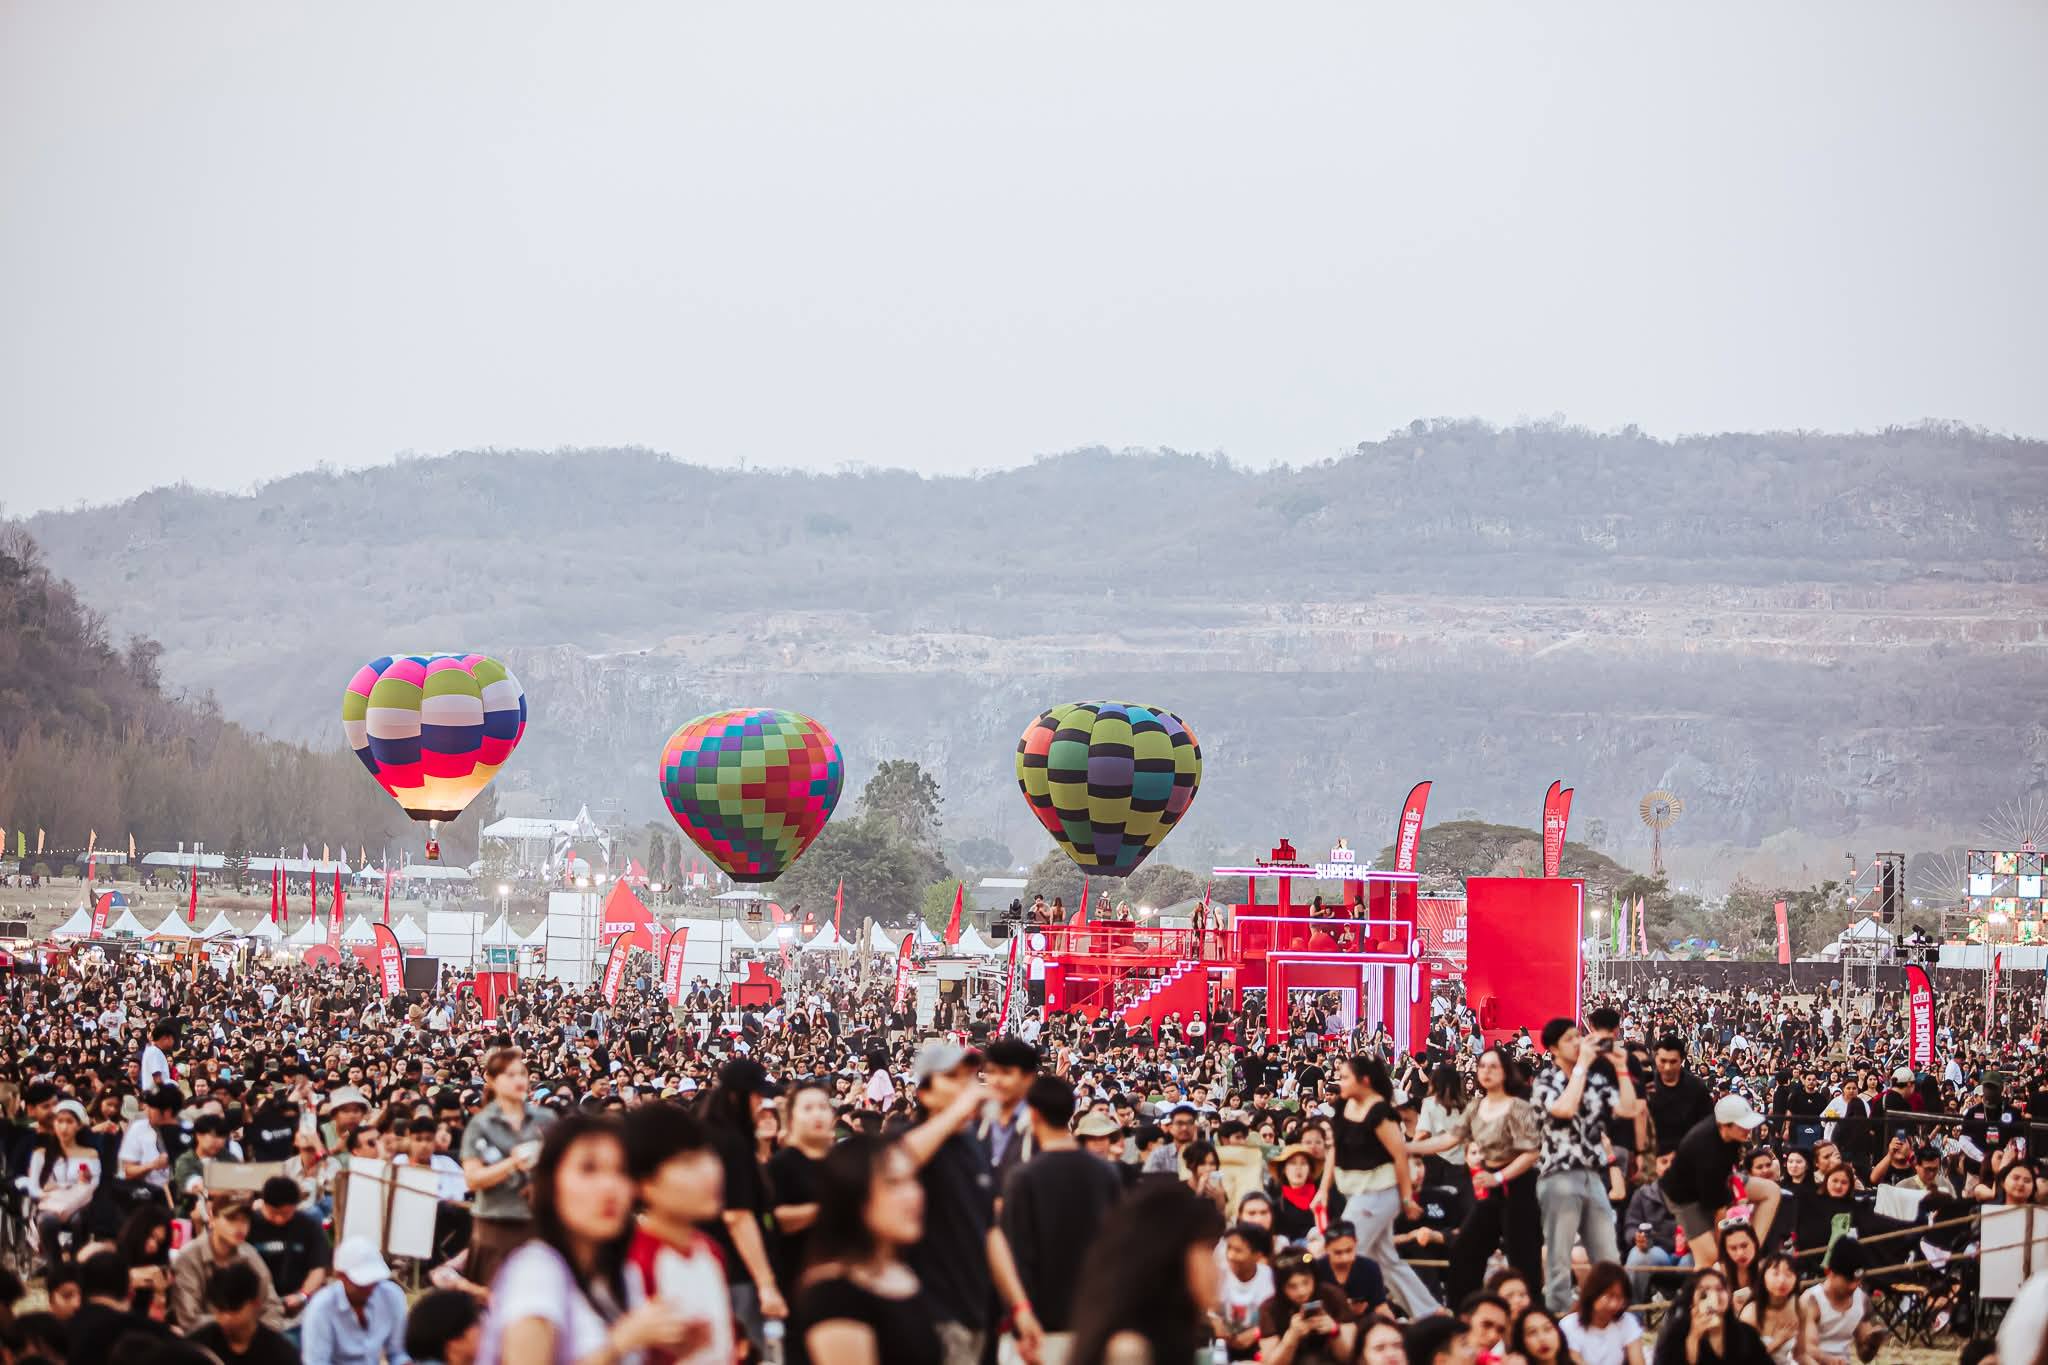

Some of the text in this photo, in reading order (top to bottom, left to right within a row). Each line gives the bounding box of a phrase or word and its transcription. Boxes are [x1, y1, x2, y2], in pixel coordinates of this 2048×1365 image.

[1398, 821, 1419, 870] SUPREME
[1332, 851, 1354, 861] LEO
[1315, 864, 1369, 880] SUPREME
[607, 923, 635, 932] LEO
[666, 951, 681, 995] SUPREME
